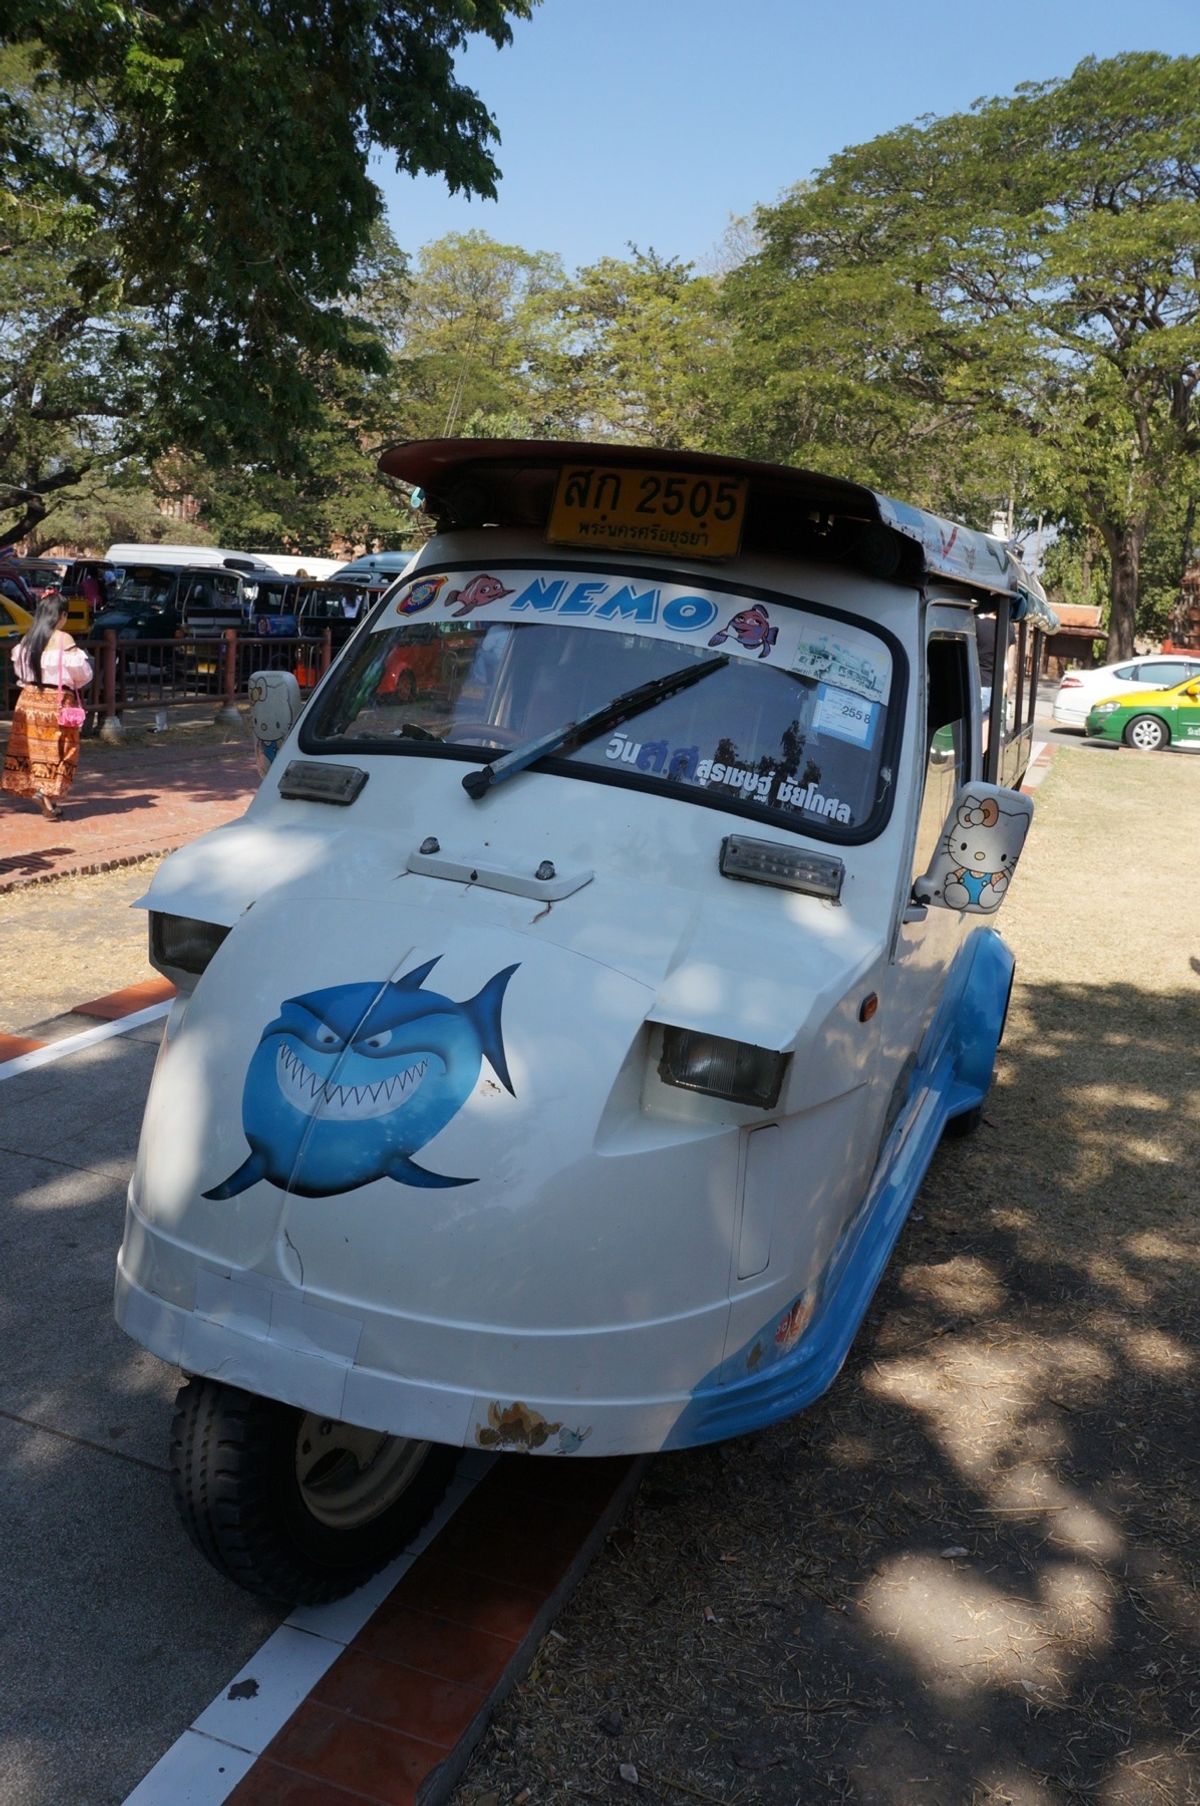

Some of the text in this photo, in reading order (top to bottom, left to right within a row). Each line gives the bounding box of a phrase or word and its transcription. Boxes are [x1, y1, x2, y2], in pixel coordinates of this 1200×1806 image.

[564, 469, 740, 521] สก 2505
[578, 521, 709, 547] พระนครศรีอยุธยา
[510, 576, 718, 632] NEMO
